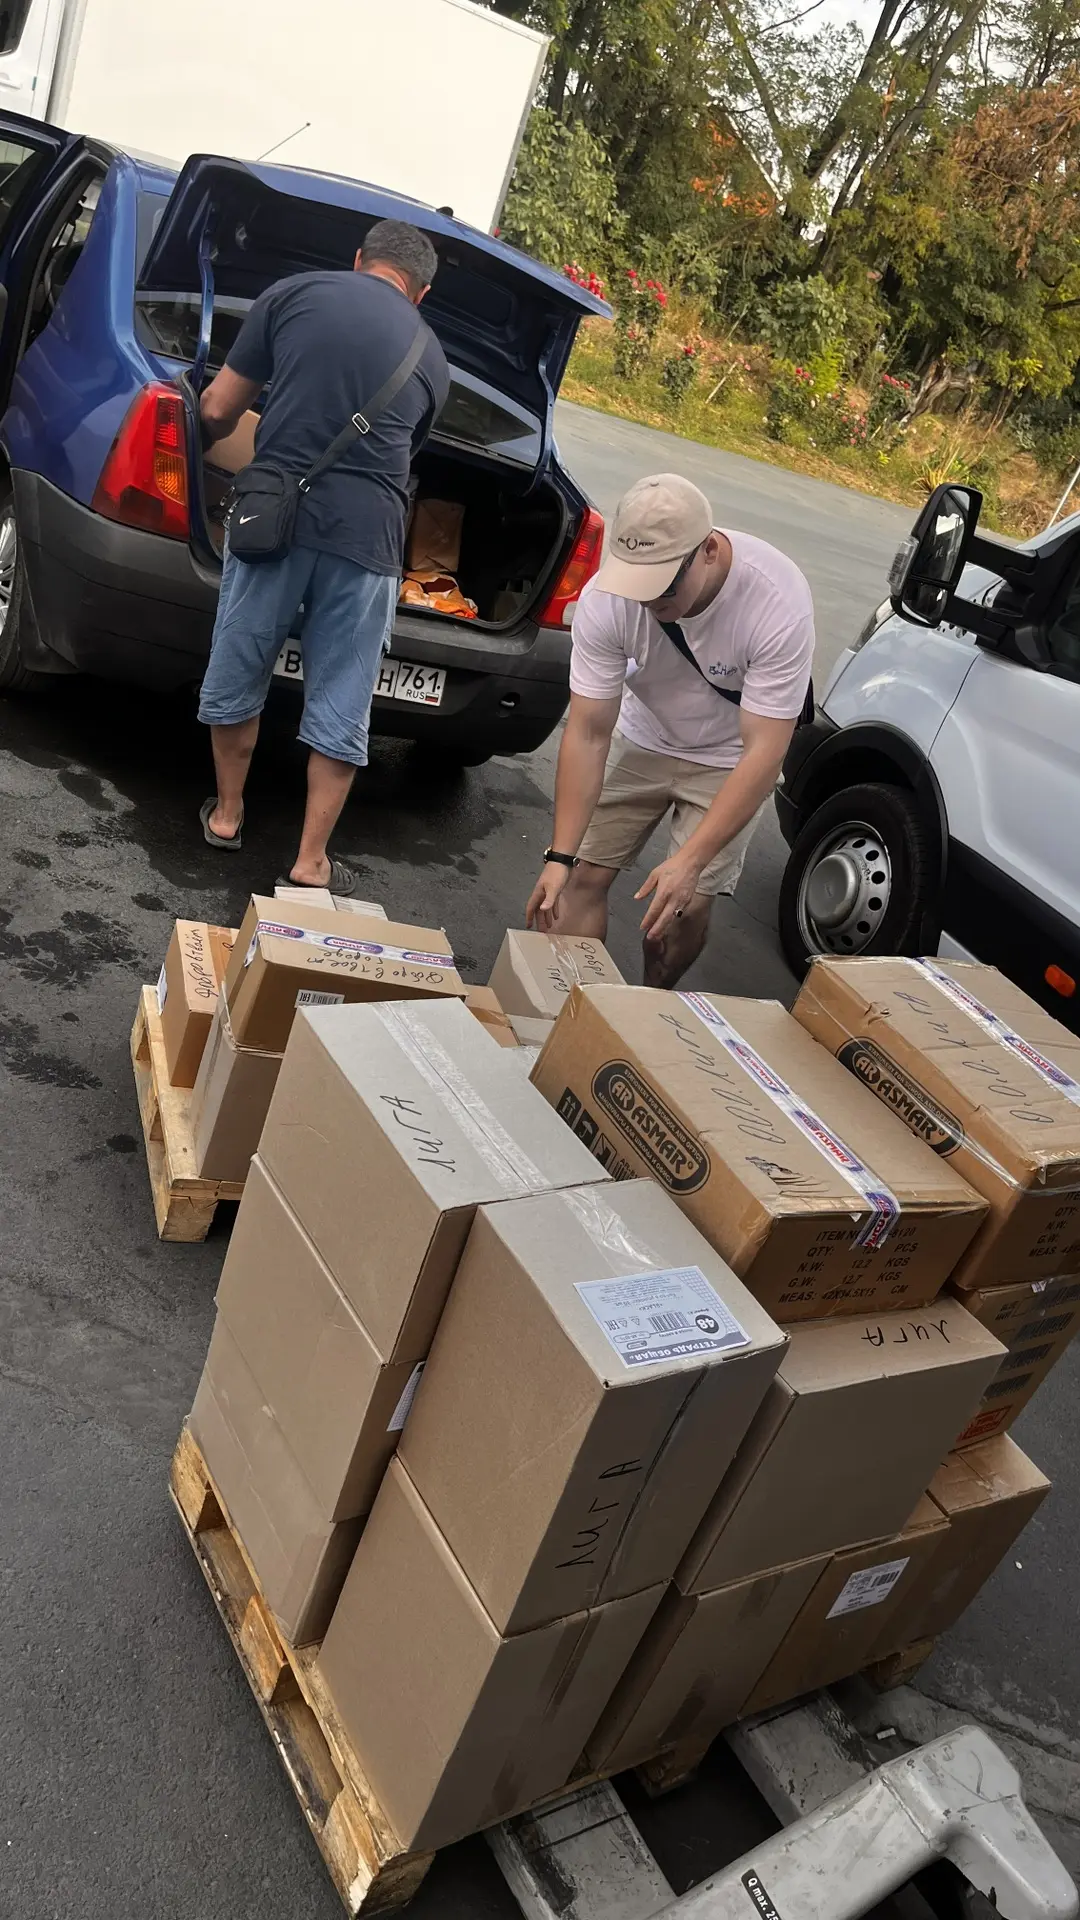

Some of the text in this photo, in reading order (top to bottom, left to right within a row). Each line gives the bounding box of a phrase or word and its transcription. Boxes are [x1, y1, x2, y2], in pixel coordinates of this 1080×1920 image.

[400, 665, 438, 693] 761
[405, 689, 425, 700] RUS
[855, 1056, 878, 1081] AR
[611, 1082, 633, 1108] AR
[904, 1082, 924, 1101] SCHOOL
[624, 1069, 704, 1163] STATIONERY FOR SCHOOL AND OFFICE
[876, 1079, 937, 1140] ASMAR
[630, 1106, 686, 1174] ASMAR
[625, 1125, 636, 1138] ДЛЯ
[635, 1138, 653, 1159] ШКОЛЫ
[656, 1164, 673, 1185] ОФИСА
[815, 1231, 847, 1242] ITEM
[806, 1246, 835, 1257] QTY:
[894, 1243, 918, 1253] PCS
[885, 1257, 910, 1268] KGS
[876, 1272, 902, 1283] KGS
[778, 1291, 817, 1303] MEAS:
[890, 1285, 908, 1295] CM
[697, 1317, 715, 1329] 48
[635, 1340, 716, 1361] ТЕТРАДЬ ОБЩАЯ
[747, 1877, 758, 1887] Q
[753, 1887, 768, 1910] max.
